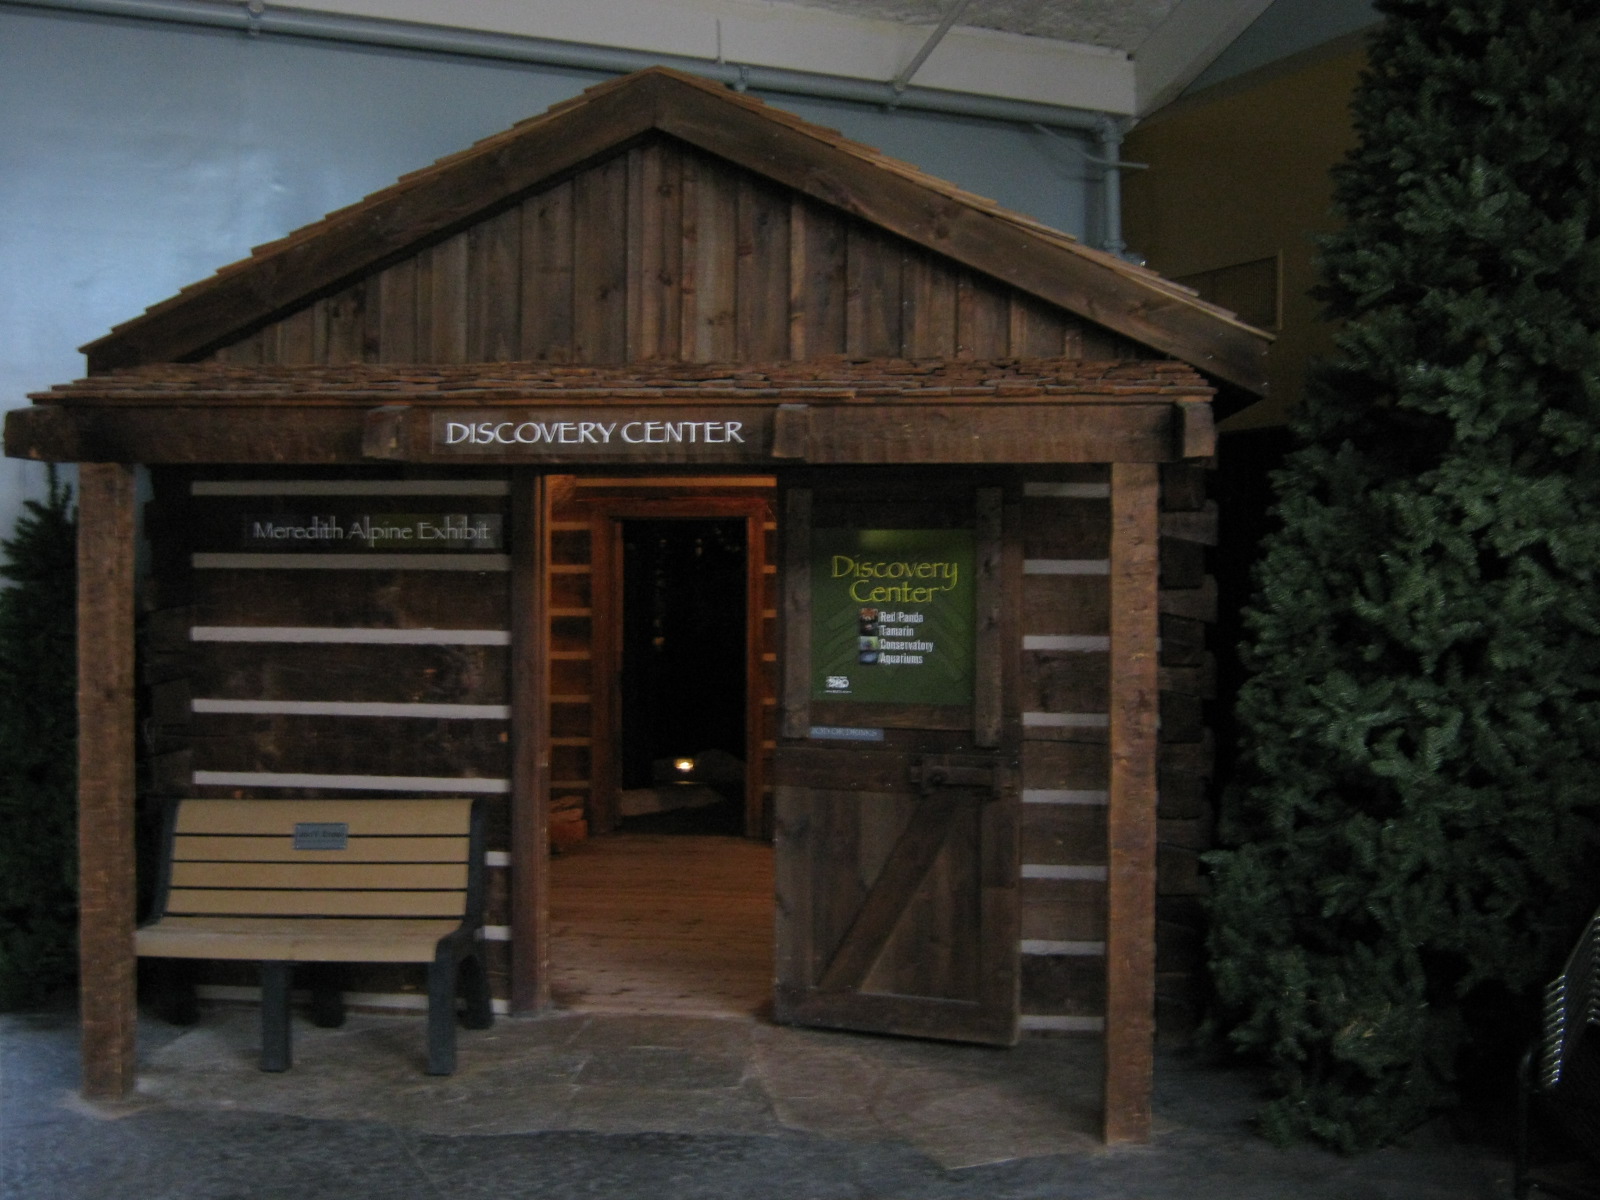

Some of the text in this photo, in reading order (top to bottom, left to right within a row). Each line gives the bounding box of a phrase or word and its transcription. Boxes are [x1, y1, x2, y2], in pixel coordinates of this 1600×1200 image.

[446, 421, 745, 444] DISCOVERY CENTER
[252, 515, 491, 548] Meredith Alpine Exhibit
[831, 554, 959, 603] Discovery Center
[878, 611, 924, 623] Red Panda
[879, 625, 914, 637] Tamarin
[879, 638, 934, 652] Conservatory
[878, 652, 924, 665] Aquariums
